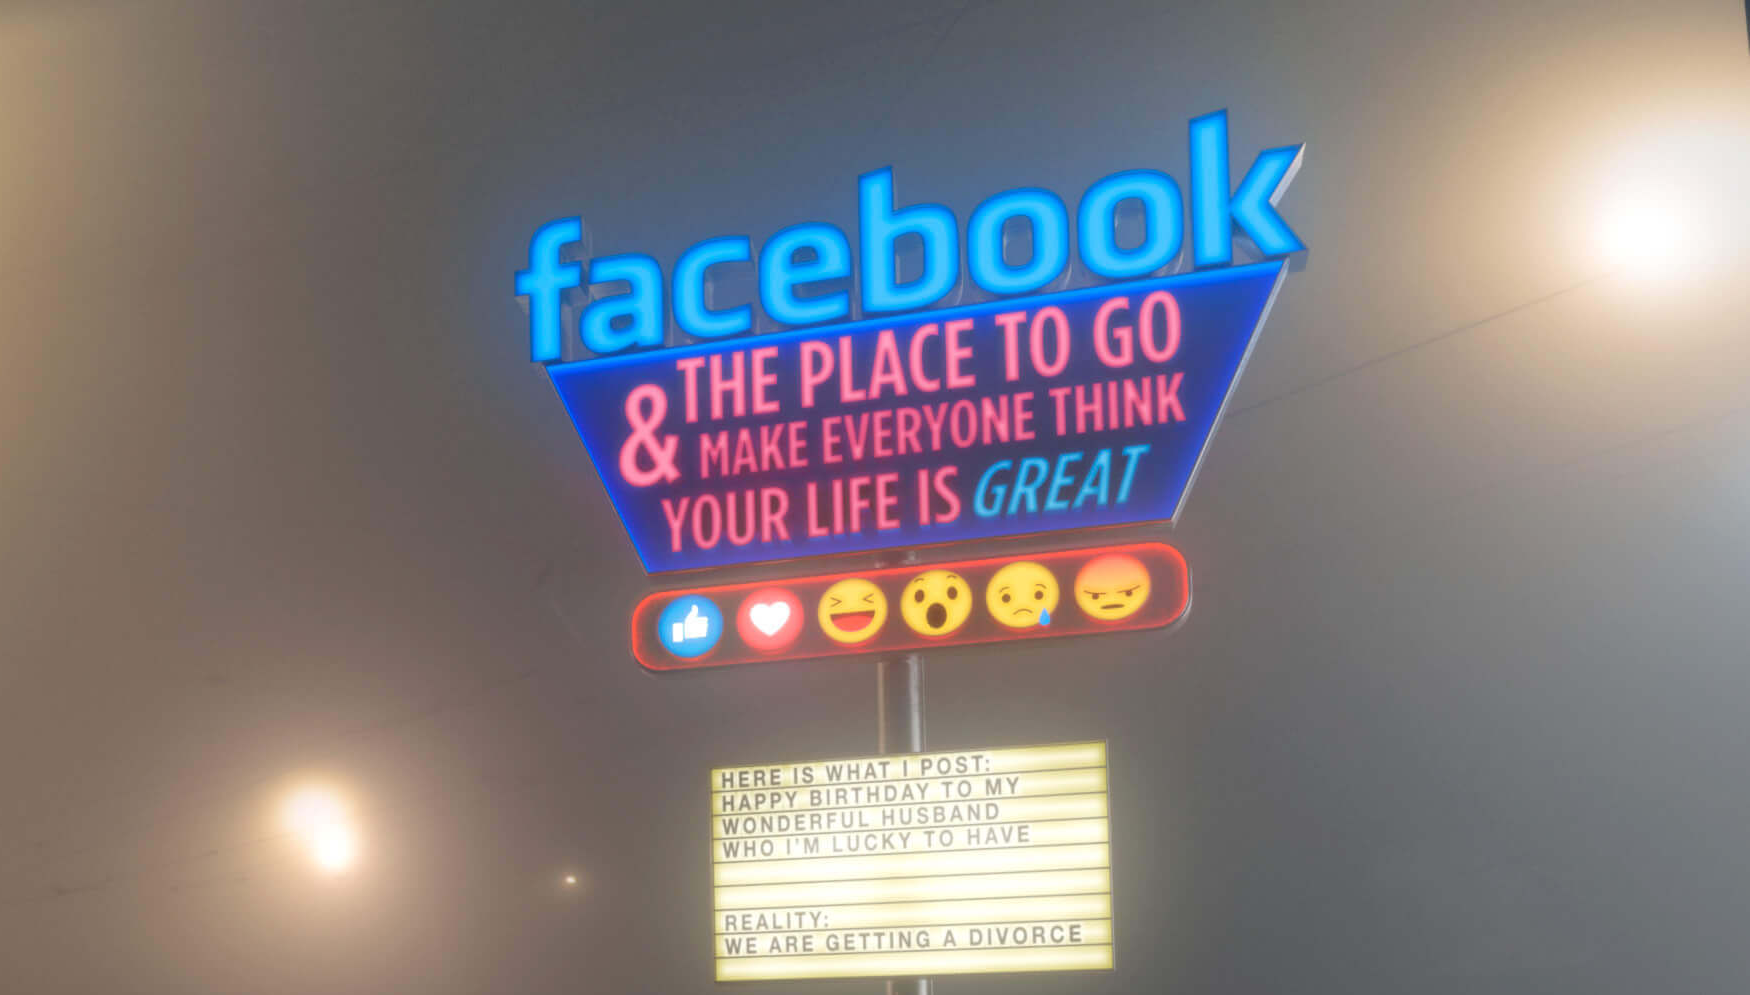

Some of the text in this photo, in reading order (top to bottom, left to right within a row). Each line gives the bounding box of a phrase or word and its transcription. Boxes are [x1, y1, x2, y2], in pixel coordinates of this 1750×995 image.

[515, 109, 1307, 363] facebook
[677, 290, 1181, 423] THE PLACE TO GO
[619, 372, 1186, 486] & MAKE EVERYONE THINK
[662, 444, 1150, 553] YOUR LIFE IS GREAT
[722, 755, 990, 788] HERE IS WHAT I POST:
[722, 777, 1020, 812] HAPPY BIRTHDAY TO MY
[722, 803, 999, 835] WONDERFUL HUSBAND
[722, 825, 1030, 858] WHO I'M LUCKY TO HAVE
[725, 912, 829, 931] REALITY:
[725, 924, 1082, 955] WE ARE GETTING A DIVORCE
